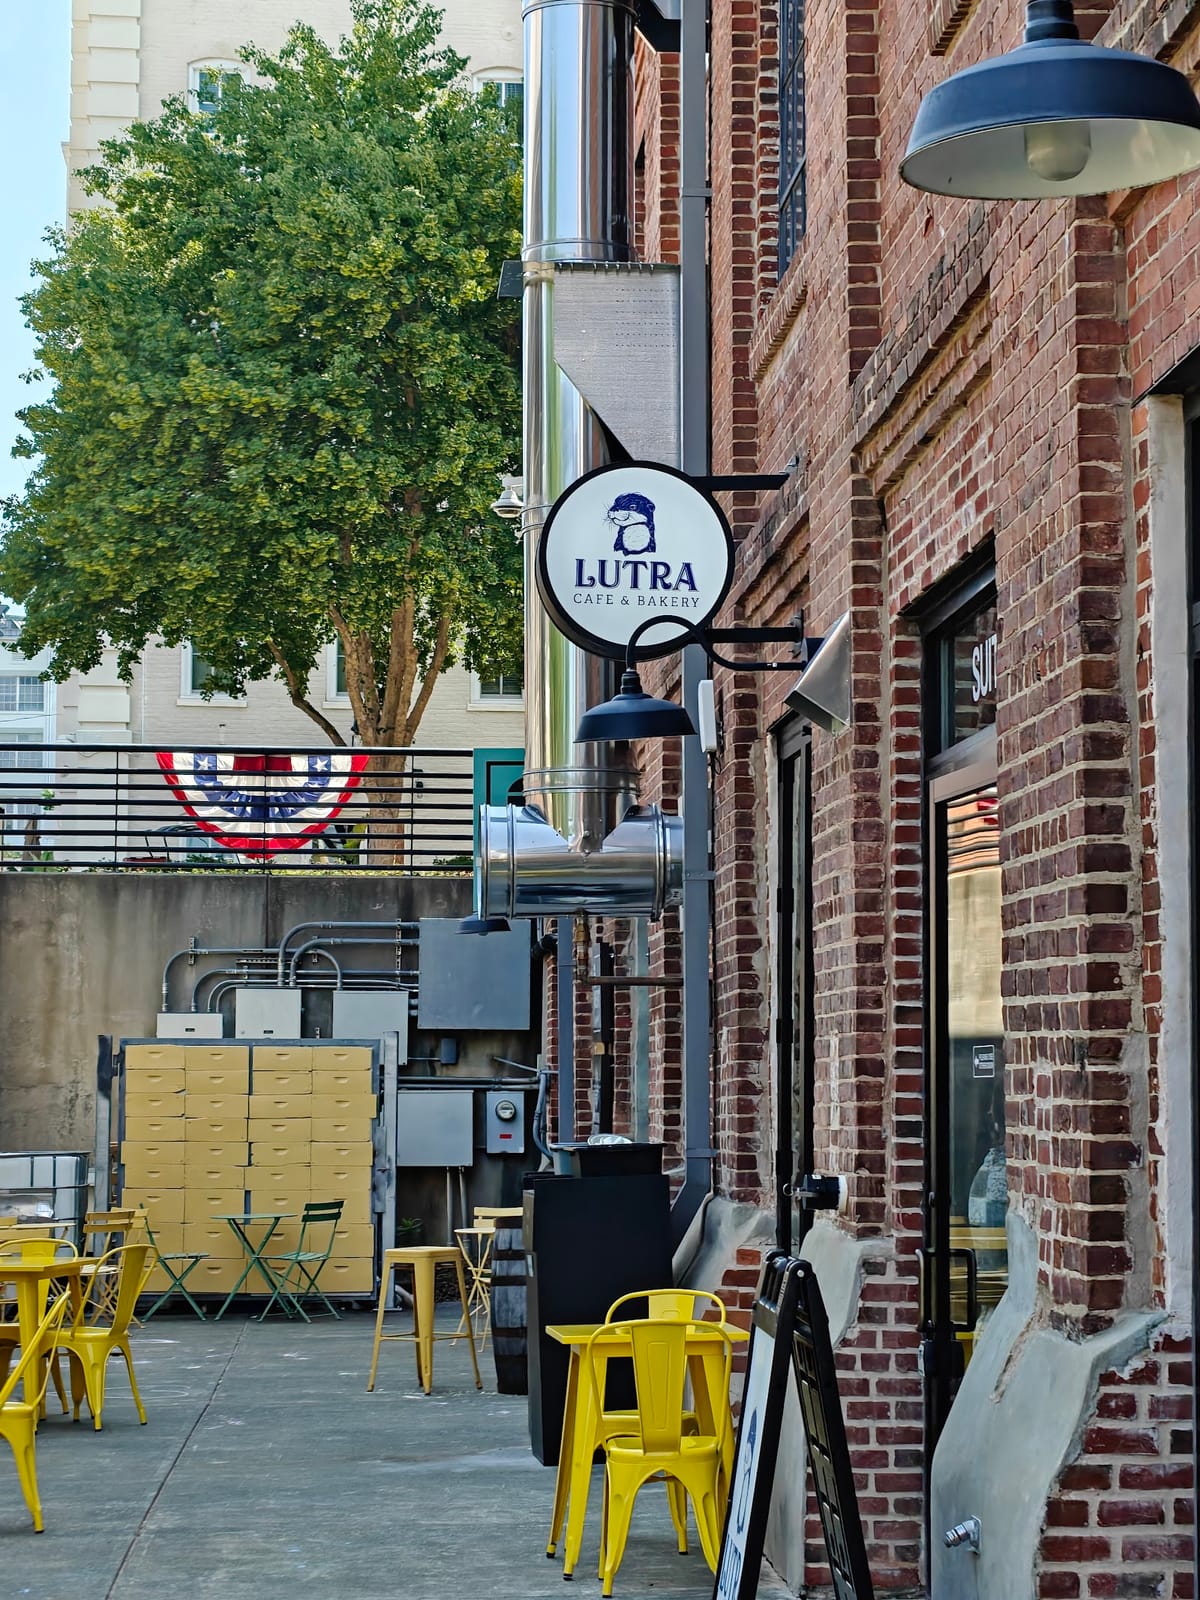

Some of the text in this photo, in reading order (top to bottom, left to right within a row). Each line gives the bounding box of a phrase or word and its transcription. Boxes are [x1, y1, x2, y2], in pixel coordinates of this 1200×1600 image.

[575, 558, 699, 592] LUTRA
[573, 593, 701, 608] CAFE & BAKERY
